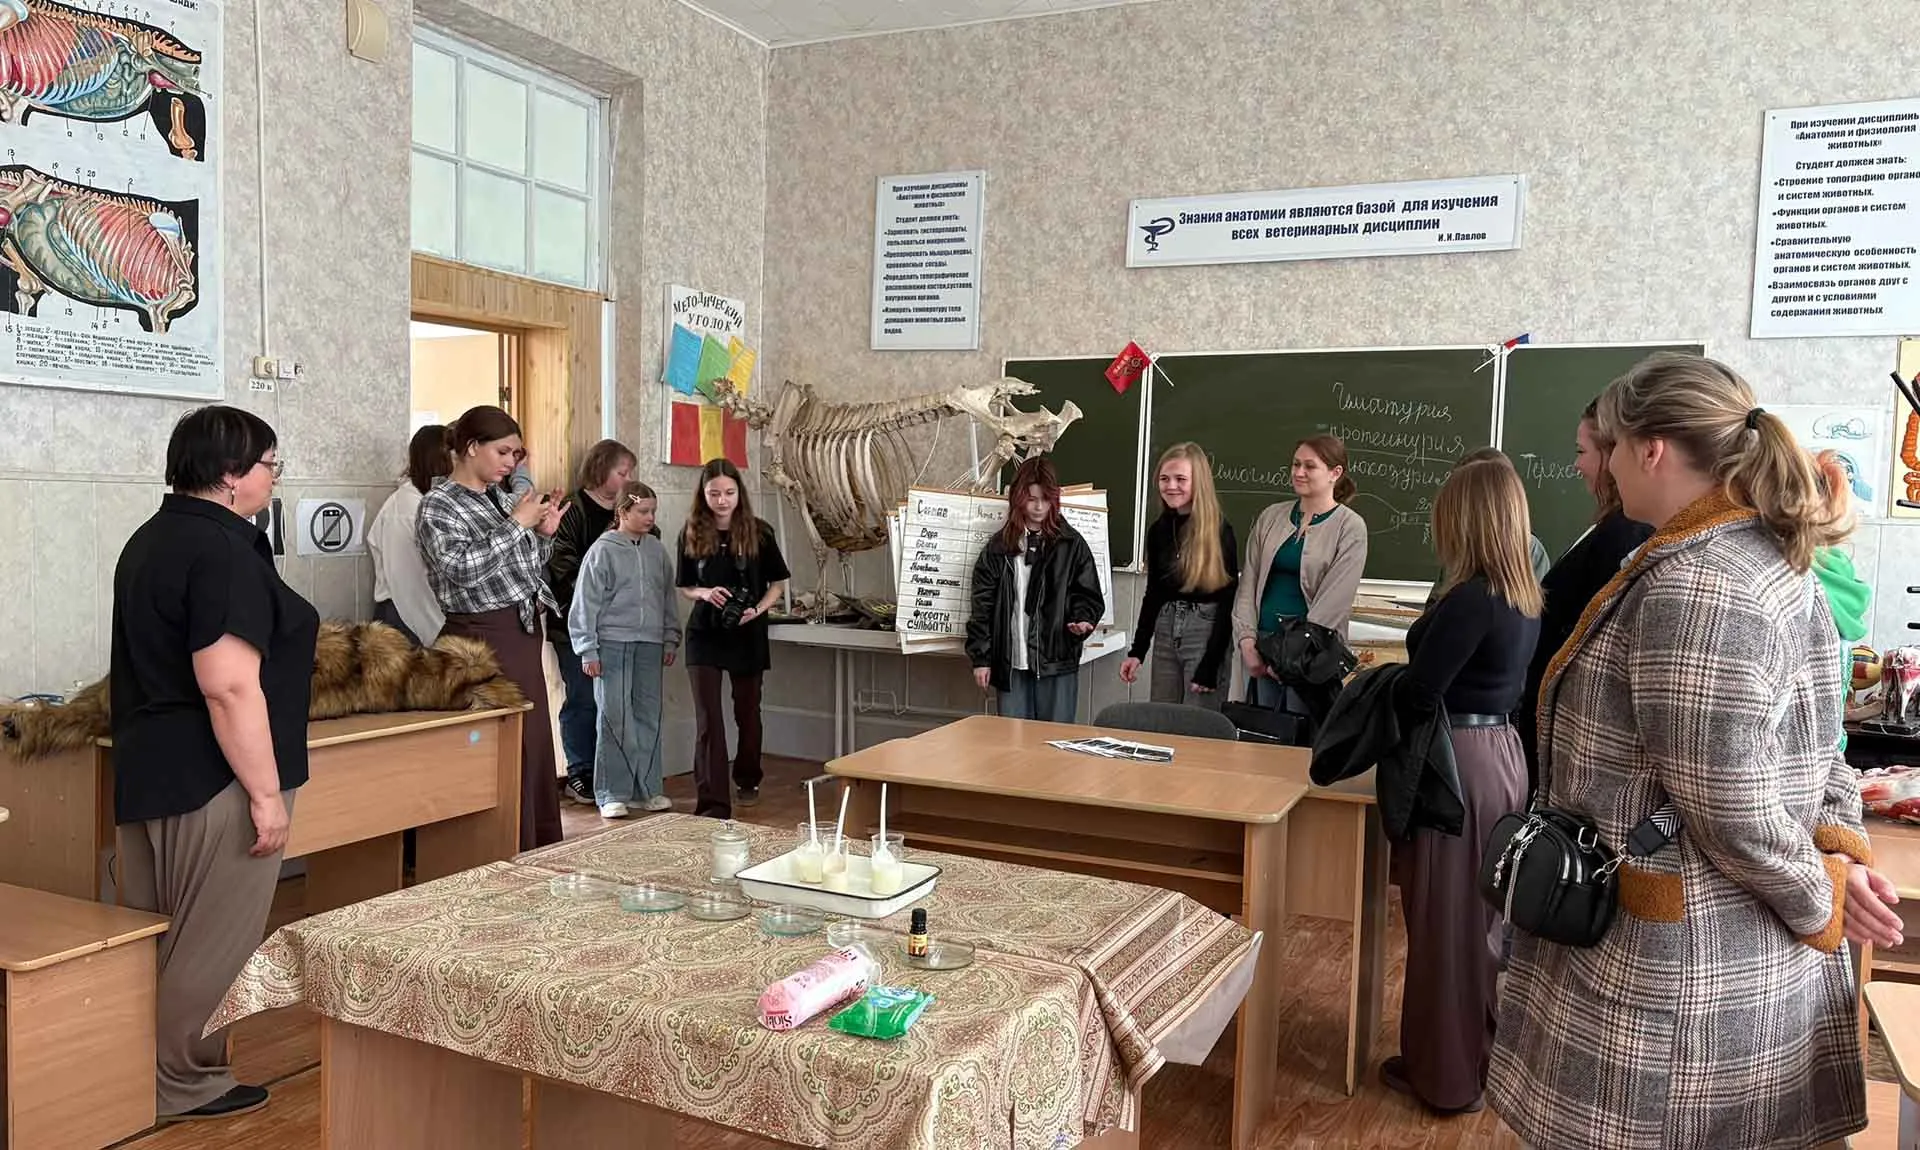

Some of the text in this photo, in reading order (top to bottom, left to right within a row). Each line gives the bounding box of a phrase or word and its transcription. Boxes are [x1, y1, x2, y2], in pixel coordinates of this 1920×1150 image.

[1791, 120, 1808, 129] При
[1810, 117, 1856, 128] изучении
[1796, 124, 1916, 140] «Анатомия и физиология
[1828, 140, 1882, 150] животных»
[1796, 156, 1907, 170] Студент должен знать:
[1779, 176, 1824, 187] Строение
[1826, 173, 1885, 184] топографию
[1786, 190, 1820, 200] систем
[1822, 188, 1874, 198] животных.
[1179, 194, 1498, 225] Знания анатомии являются базой для изучения
[1777, 202, 1906, 217] Функции органов и систем
[1232, 217, 1440, 241] всех ветеринарных дисциплин
[1776, 220, 1827, 230] животных.
[1438, 232, 1487, 243] И.И.Павлов
[1776, 235, 1851, 246] Сравнительную
[1774, 247, 1917, 260] анатомическую особенность
[1774, 261, 1911, 274] органов и систем животных.
[1772, 279, 1836, 289] Взаимосвязь
[1838, 278, 1876, 287] органов
[1878, 278, 1900, 286] друг
[1772, 294, 1806, 304] другом
[1823, 292, 1876, 302] условиями
[673, 291, 743, 329] МЕТОДИЧЕСКИЙ
[1771, 306, 1883, 317] содержания животных
[688, 313, 732, 331] УГОЛОК
[252, 381, 265, 389] 220
